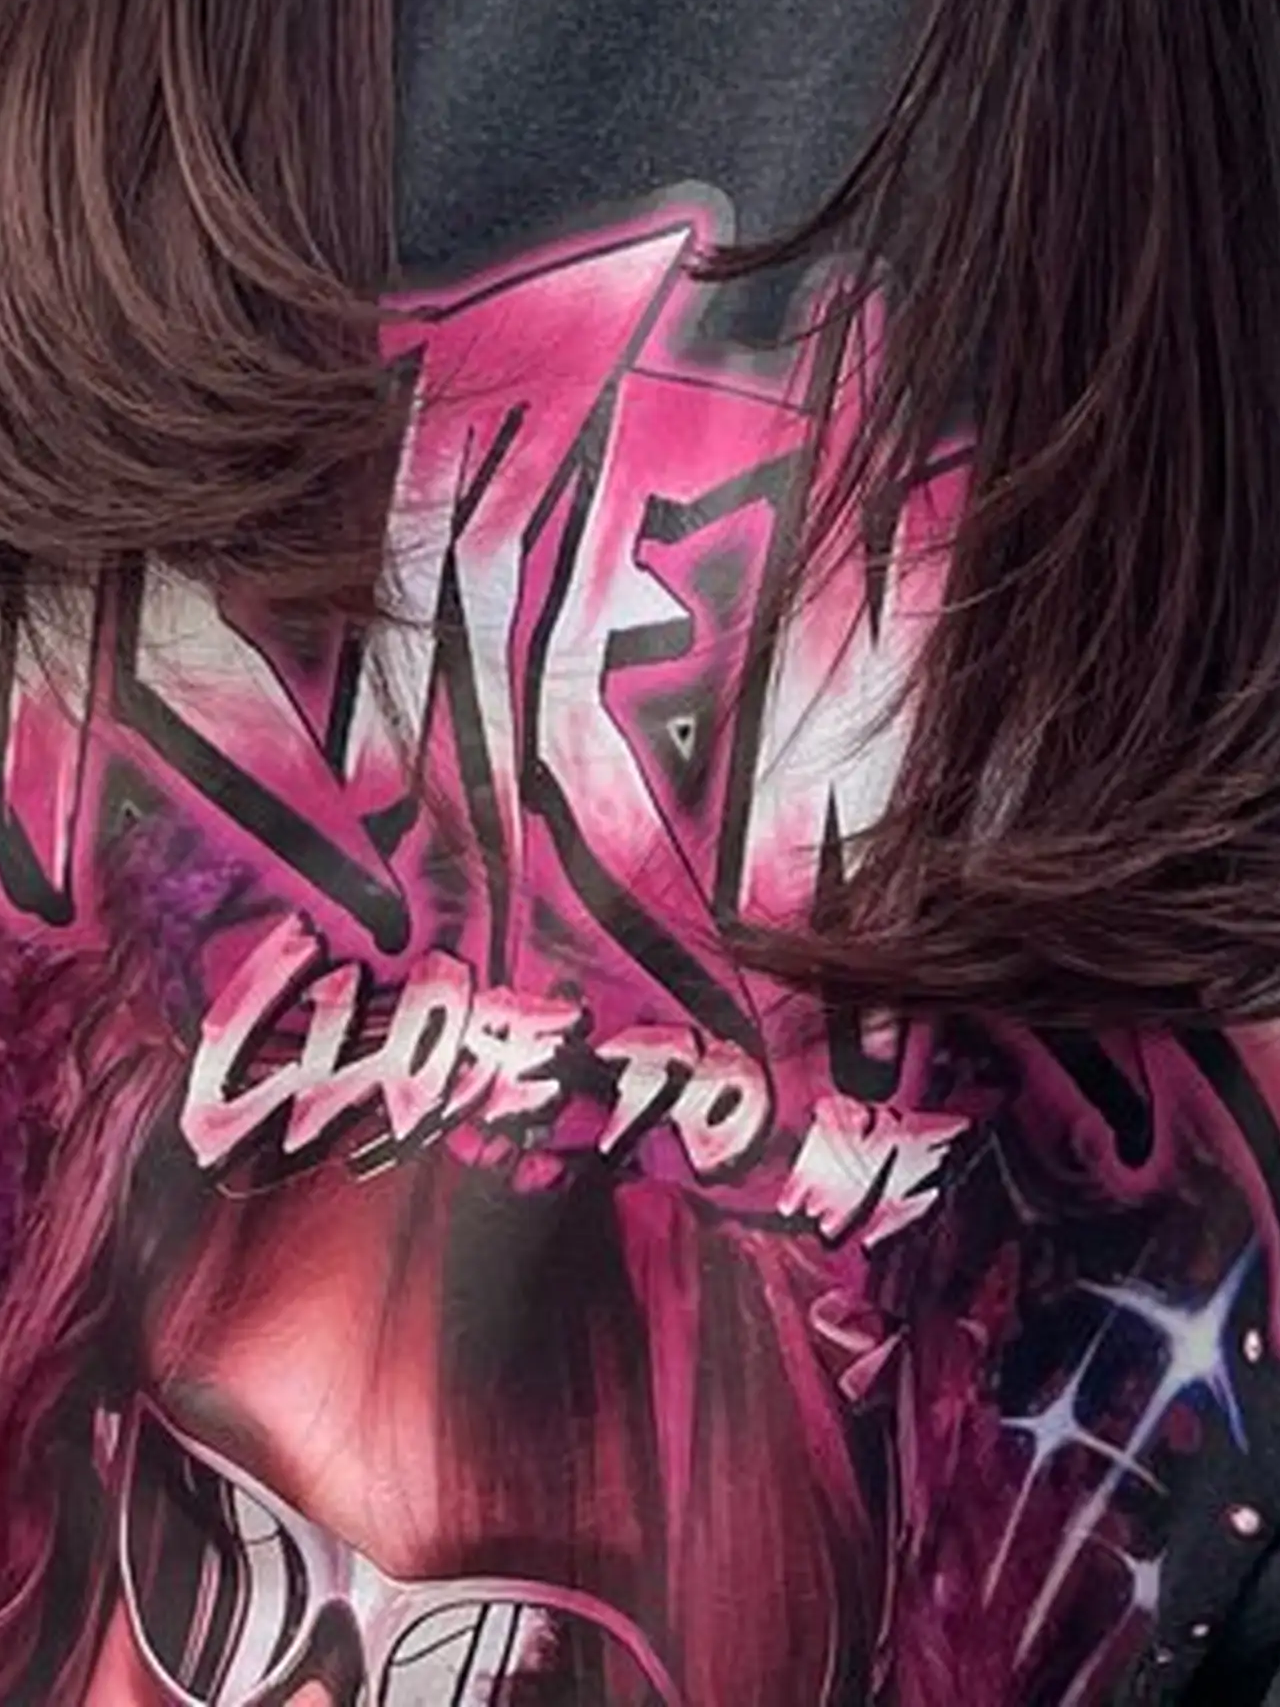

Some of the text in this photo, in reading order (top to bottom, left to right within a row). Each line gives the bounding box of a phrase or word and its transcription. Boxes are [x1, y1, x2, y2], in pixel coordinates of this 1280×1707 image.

[179, 912, 972, 1251] CLOSE TO ME
